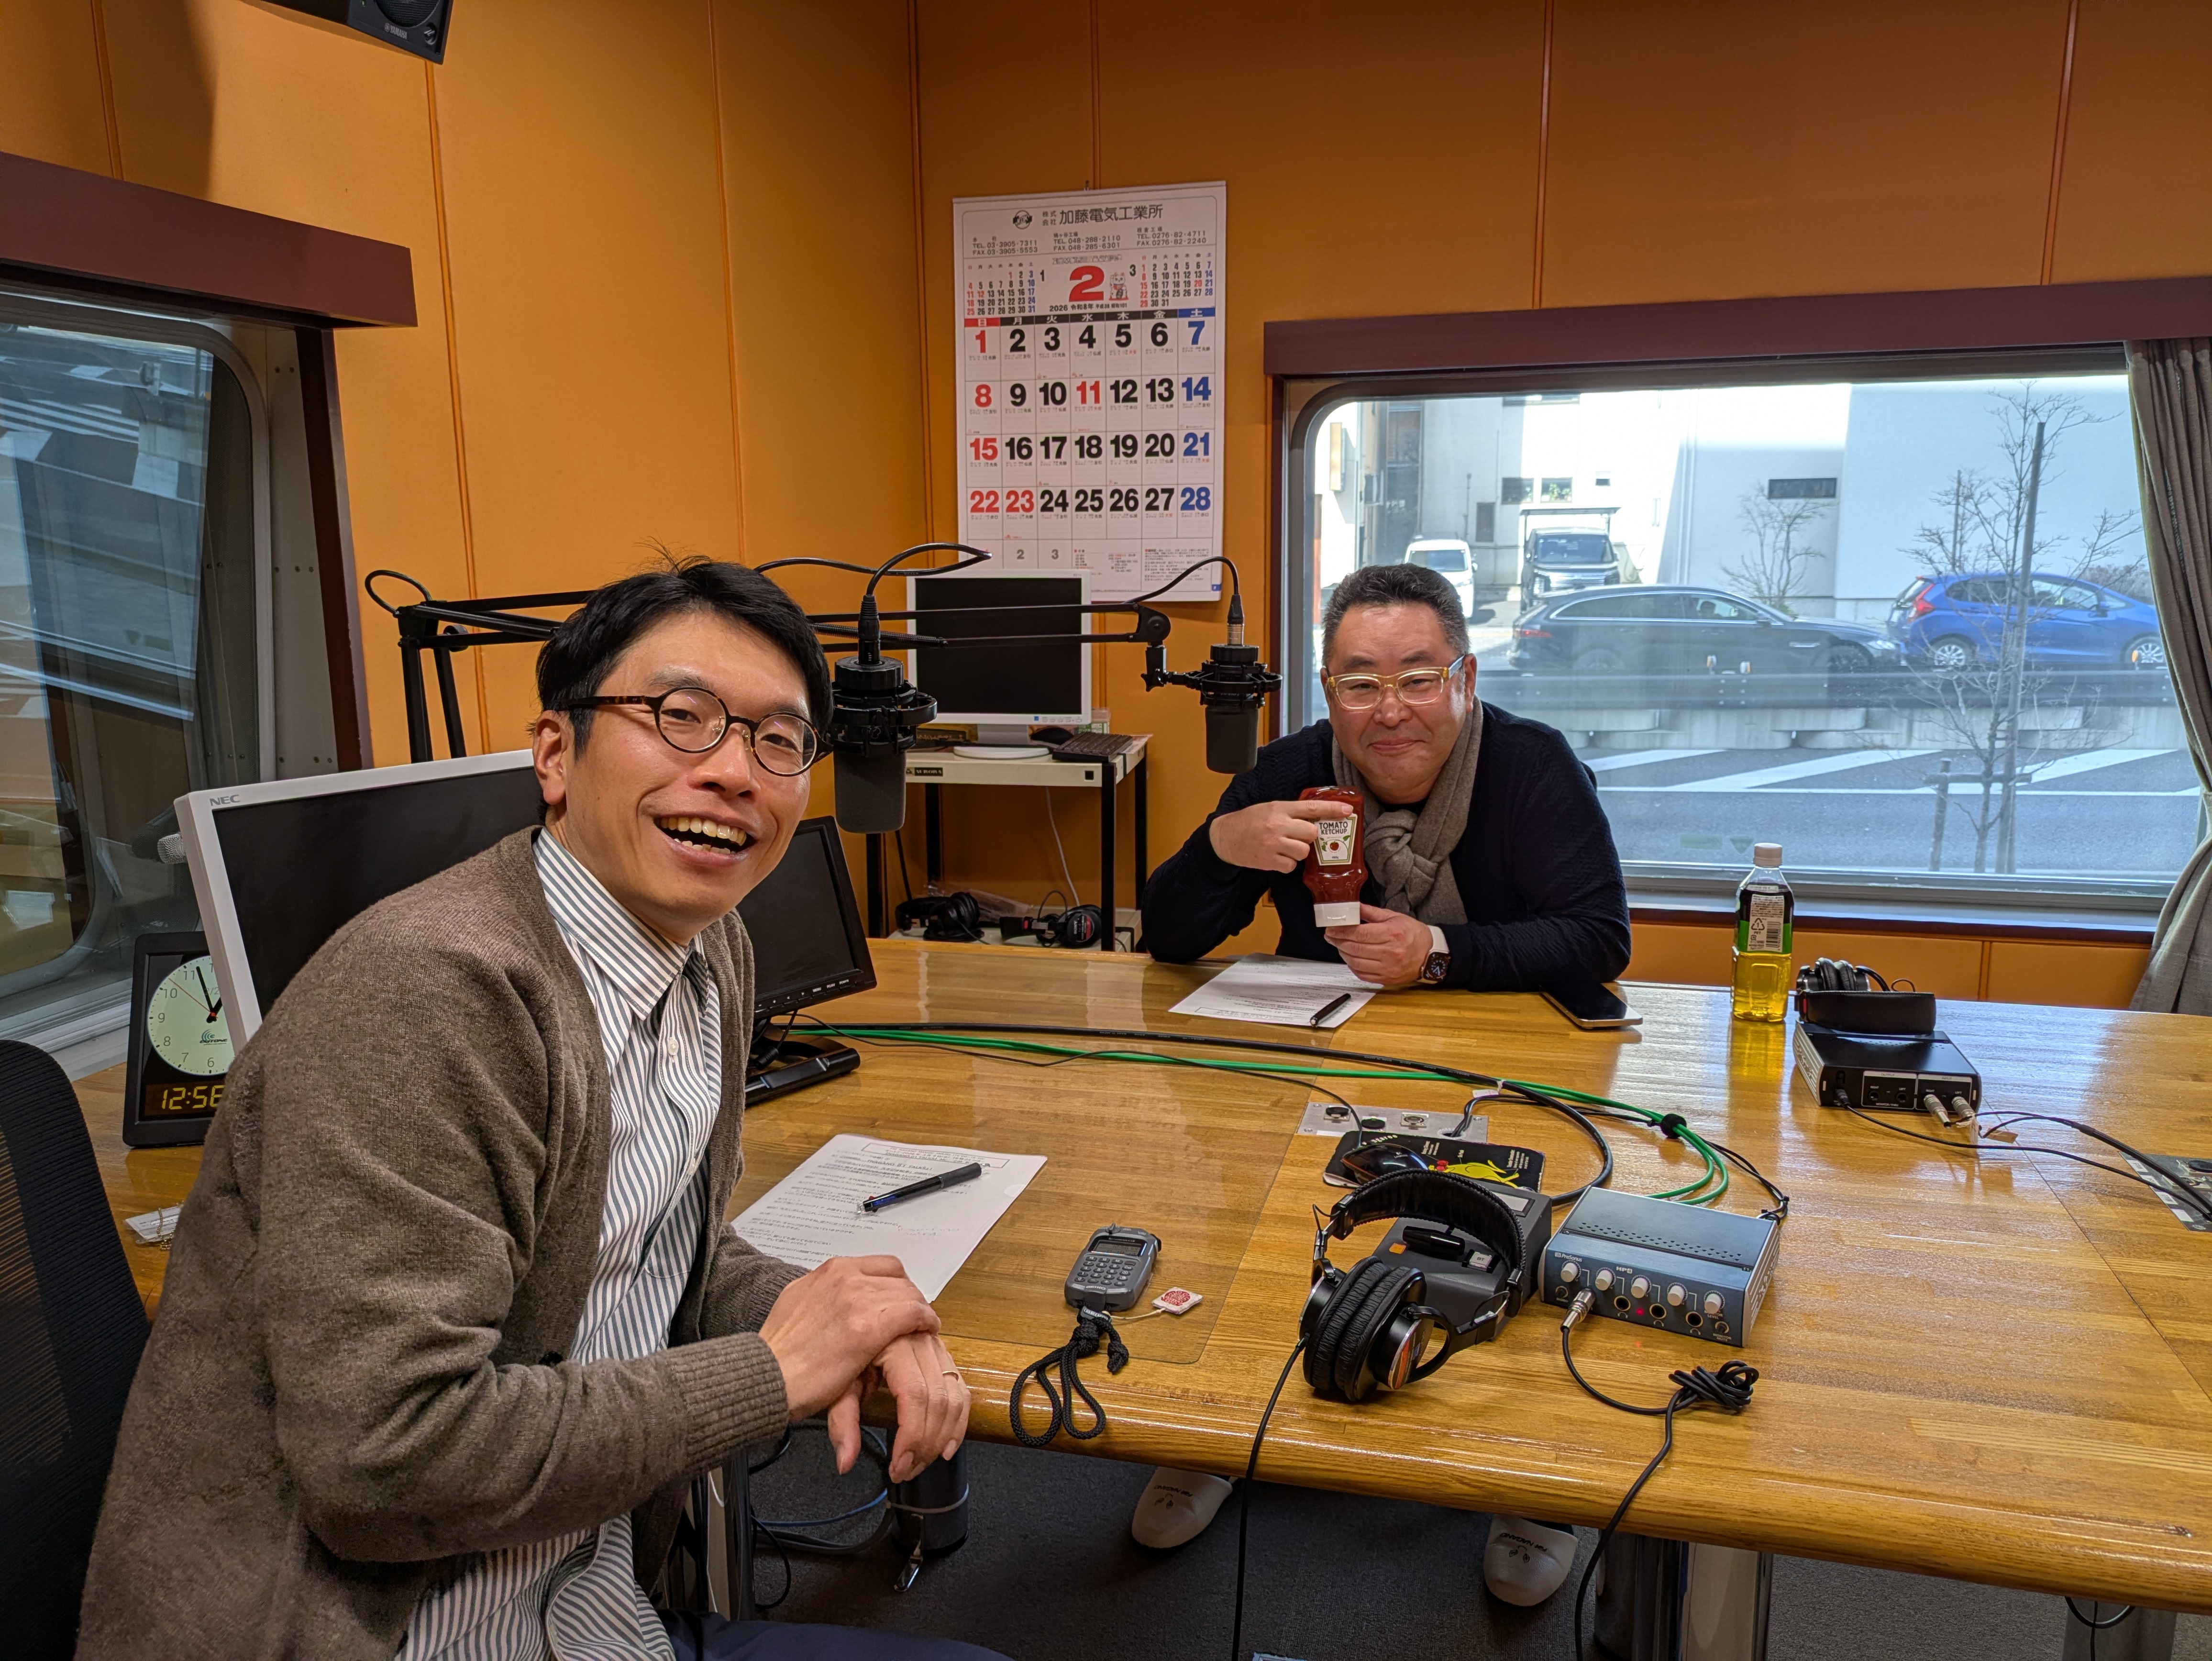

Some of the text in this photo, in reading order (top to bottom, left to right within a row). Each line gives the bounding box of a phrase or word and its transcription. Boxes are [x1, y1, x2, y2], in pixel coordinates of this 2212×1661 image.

[390, 25, 407, 39] YAMAHA
[1060, 204, 1163, 224] 加藤電気工業所
[1040, 269, 1044, 281] 1
[1129, 264, 1136, 277] 3
[1069, 266, 1104, 302] 2
[978, 318, 986, 327] 日
[1013, 317, 1022, 325] 月
[1046, 316, 1058, 324] 火
[1117, 312, 1129, 320] 木
[1153, 310, 1166, 319] 金
[1190, 309, 1203, 317] 土
[975, 321, 1205, 353] 1 2 3 4 5 6 7
[975, 376, 1211, 408] 8 9 10 11 12 13 14
[970, 432, 1209, 461] 15 16 17 18 19 20 21
[970, 487, 1210, 513] 22 23 24 25 26 27 28
[1017, 549, 1059, 560] 2 3
[210, 794, 241, 807] NEC
[183, 971, 195, 980] 11
[164, 988, 177, 998] 10
[158, 1013, 165, 1023] 9
[164, 1036, 171, 1046] 8
[182, 1052, 188, 1063] 7
[208, 1057, 214, 1067] 6
[1561, 1253, 1582, 1262] PreSonus
